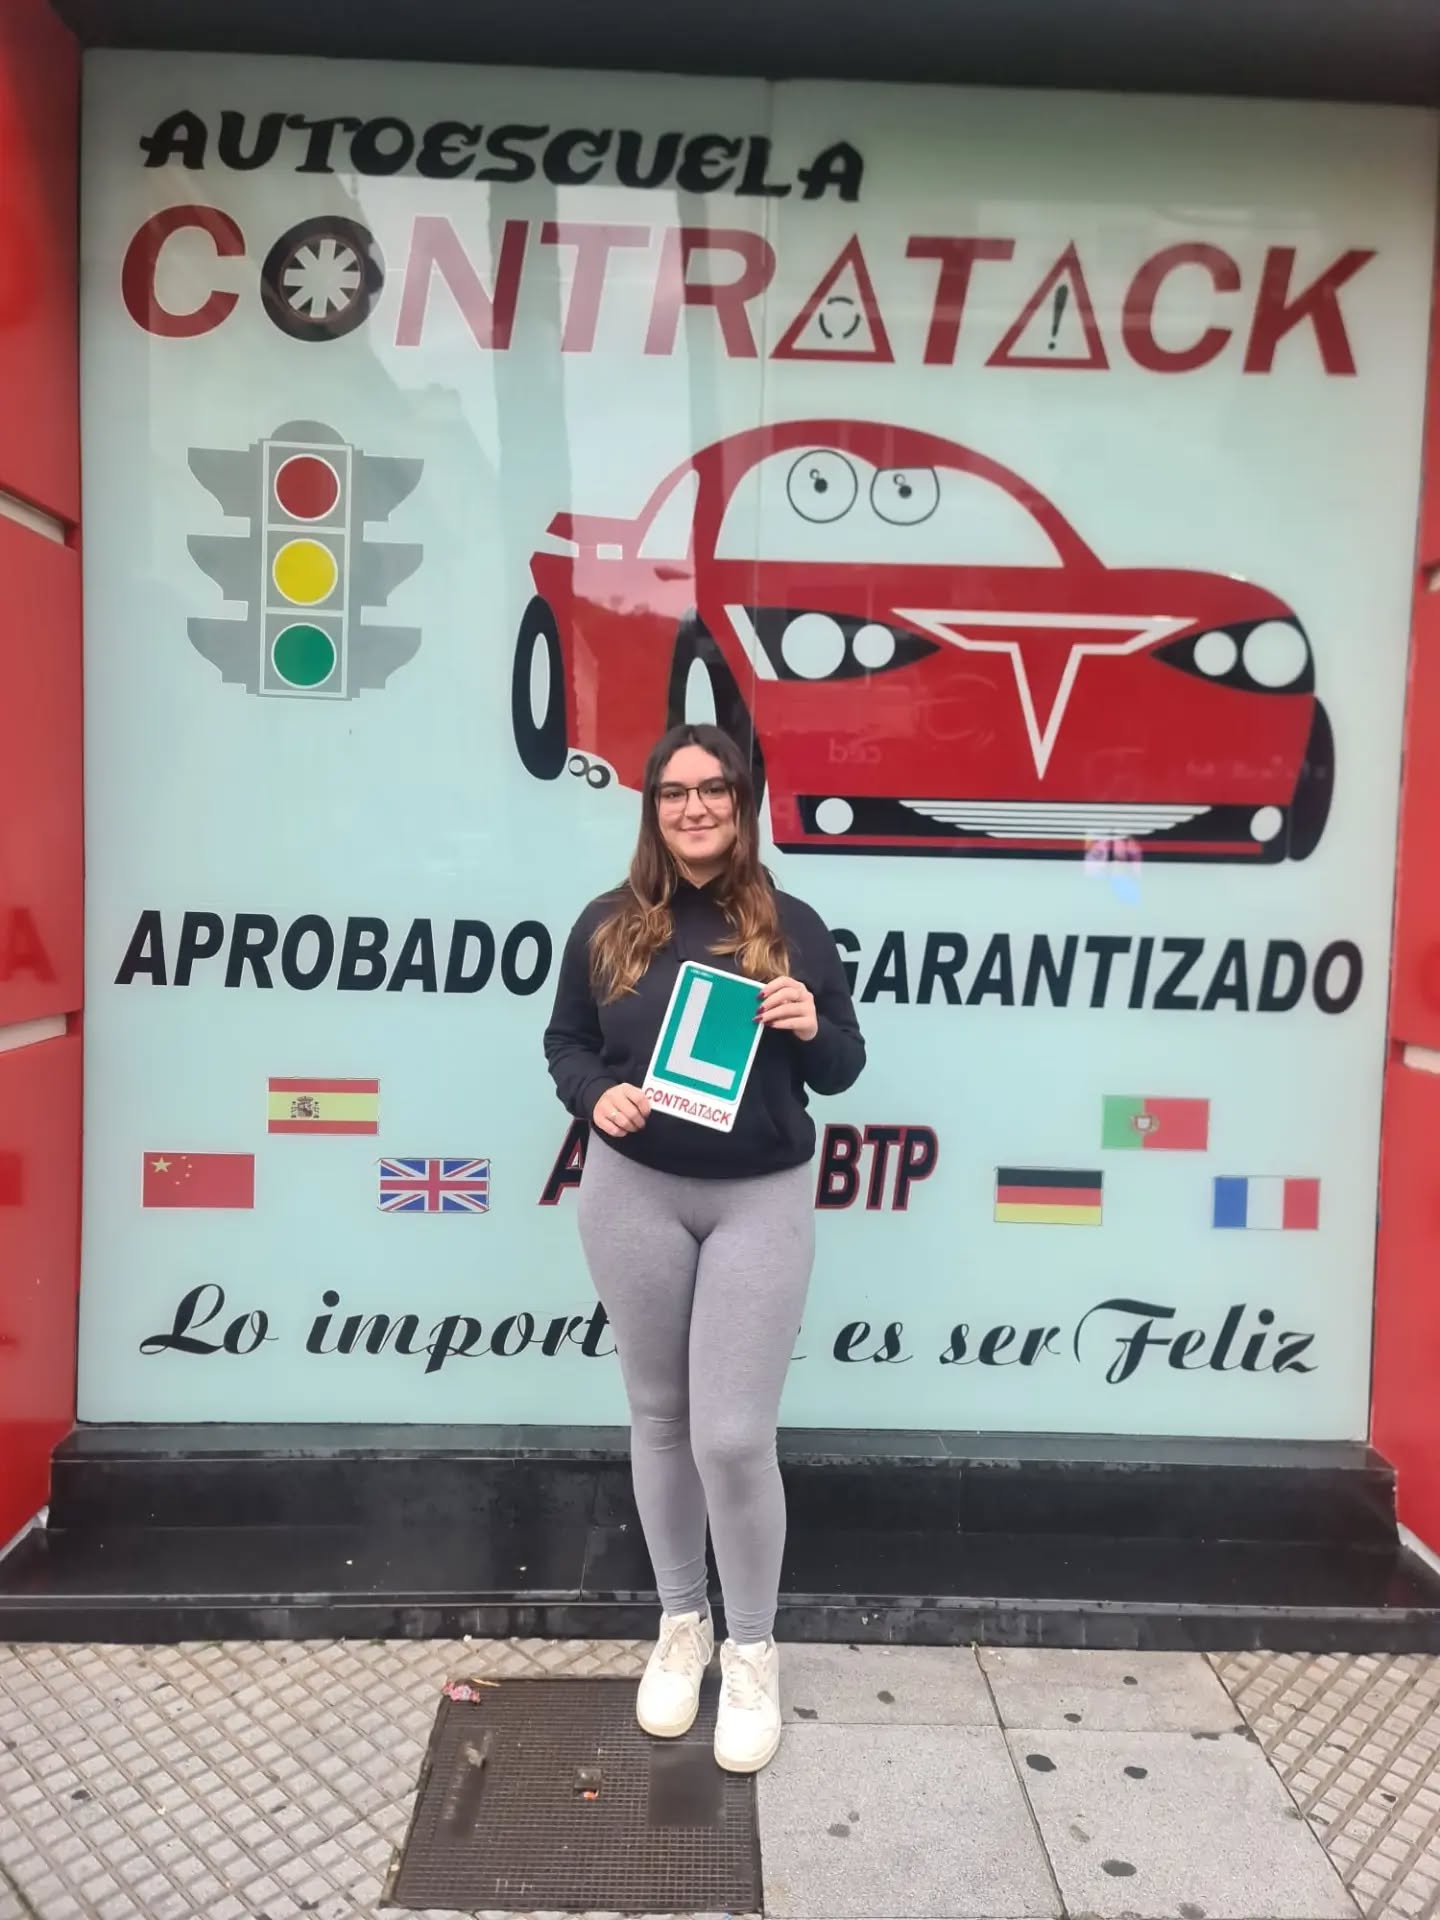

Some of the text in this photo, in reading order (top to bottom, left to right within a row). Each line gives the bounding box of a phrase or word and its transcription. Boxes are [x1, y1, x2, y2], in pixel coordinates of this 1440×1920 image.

[139, 109, 864, 201] AUTOESCUELA
[121, 204, 1377, 377] CONTRATACK
[115, 910, 552, 996] APROBADO
[665, 977, 736, 1090] L
[814, 1123, 938, 1210] BTP
[139, 1283, 1318, 1384] Lo import es ser Feliz
